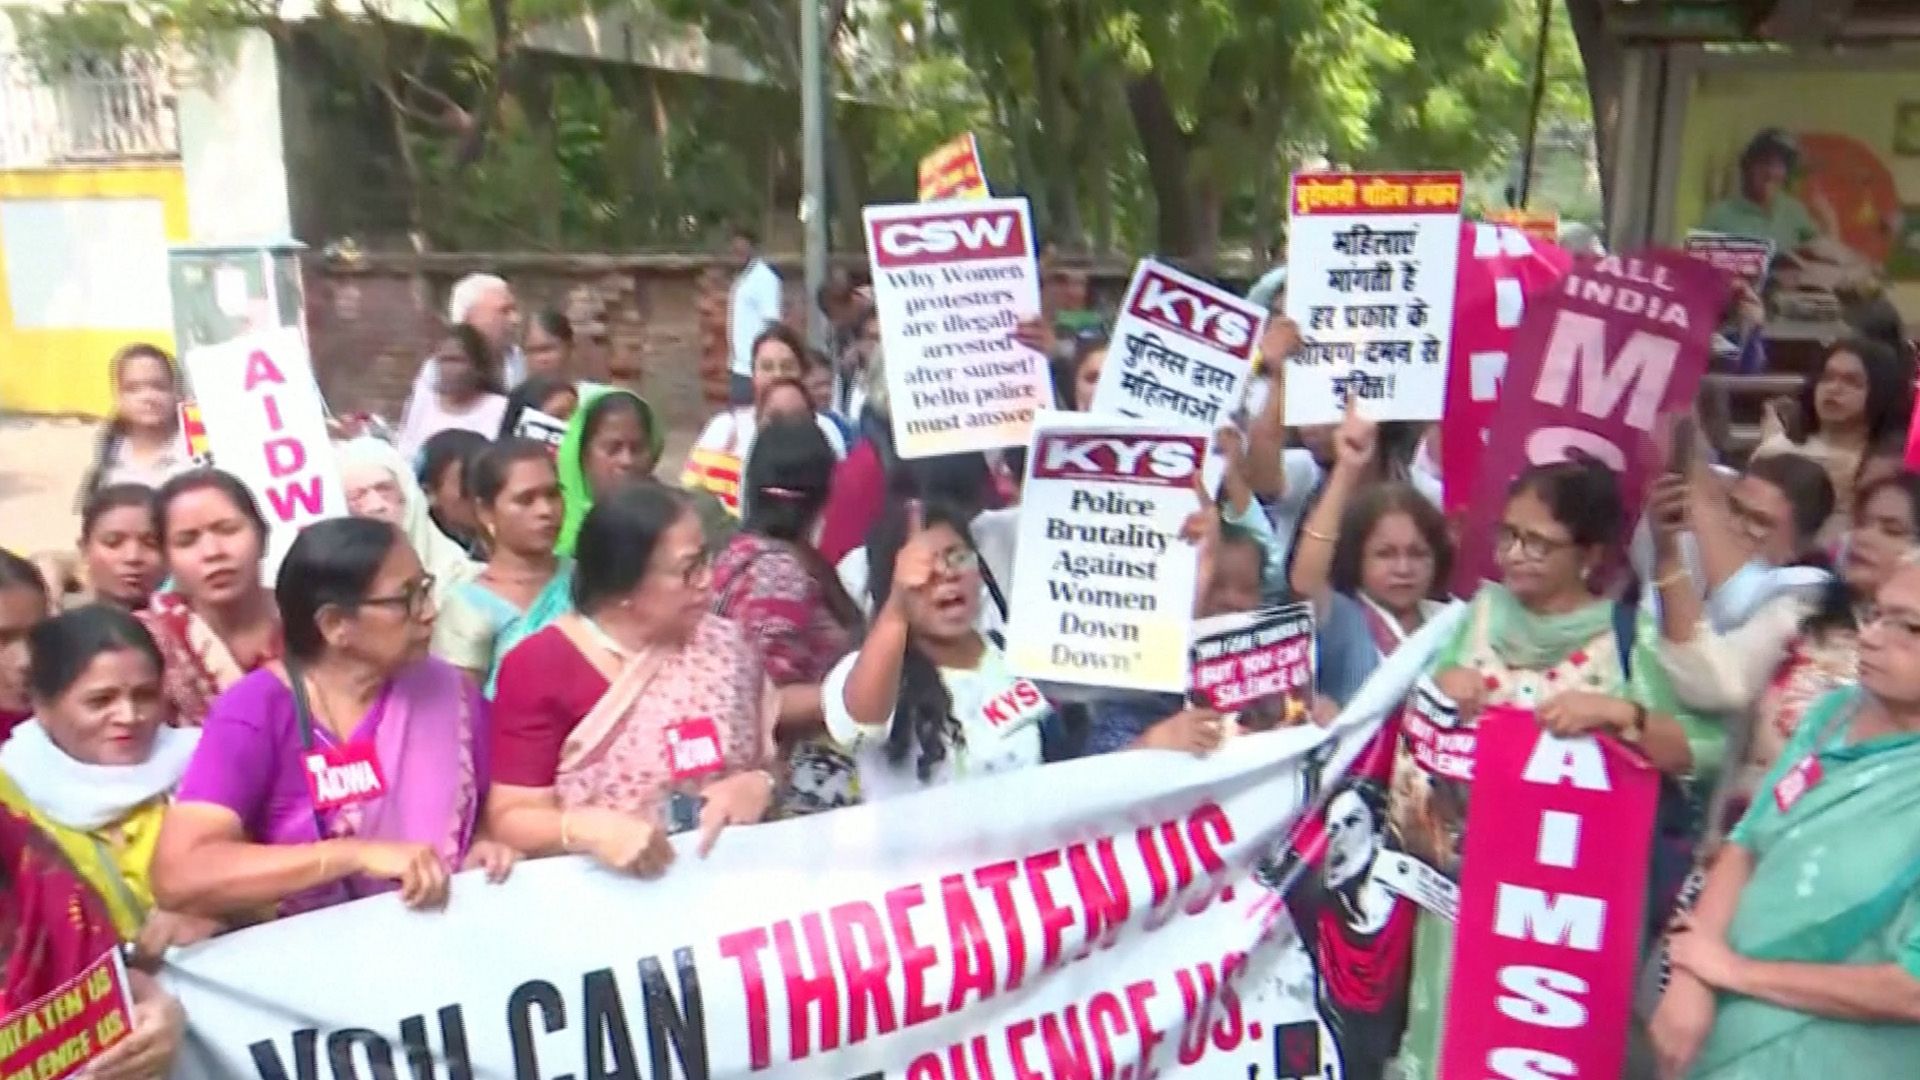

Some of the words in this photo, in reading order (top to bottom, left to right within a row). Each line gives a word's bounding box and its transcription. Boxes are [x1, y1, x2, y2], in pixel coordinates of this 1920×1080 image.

[881, 215, 1013, 257] CSW
[887, 269, 935, 290] Why
[942, 264, 1024, 284] Women
[1595, 254, 1675, 292] ALL
[905, 290, 1015, 317] protesters
[1139, 278, 1250, 347] KYS
[1309, 305, 1338, 330] हर
[1406, 297, 1432, 328] के
[1564, 275, 1689, 330] INDIA
[902, 319, 938, 337] are
[923, 336, 1014, 359] arrested
[1123, 331, 1189, 376] पुलिस
[1421, 333, 1441, 365] से
[904, 365, 958, 385] after
[913, 389, 971, 410] Delhi
[974, 382, 1036, 408] police
[243, 348, 324, 529] AIDW
[906, 414, 961, 435] must
[1045, 439, 1197, 479] KYS
[1071, 489, 1156, 517] Police
[1046, 517, 1167, 555] Brutality
[1052, 550, 1158, 580] Against
[1048, 579, 1157, 611] Women
[1059, 611, 1140, 643] Down
[982, 682, 1038, 726] KYS
[1413, 739, 1477, 781] SILENC
[718, 836, 1130, 1072] THREATEN
[1136, 800, 1236, 931] US.
